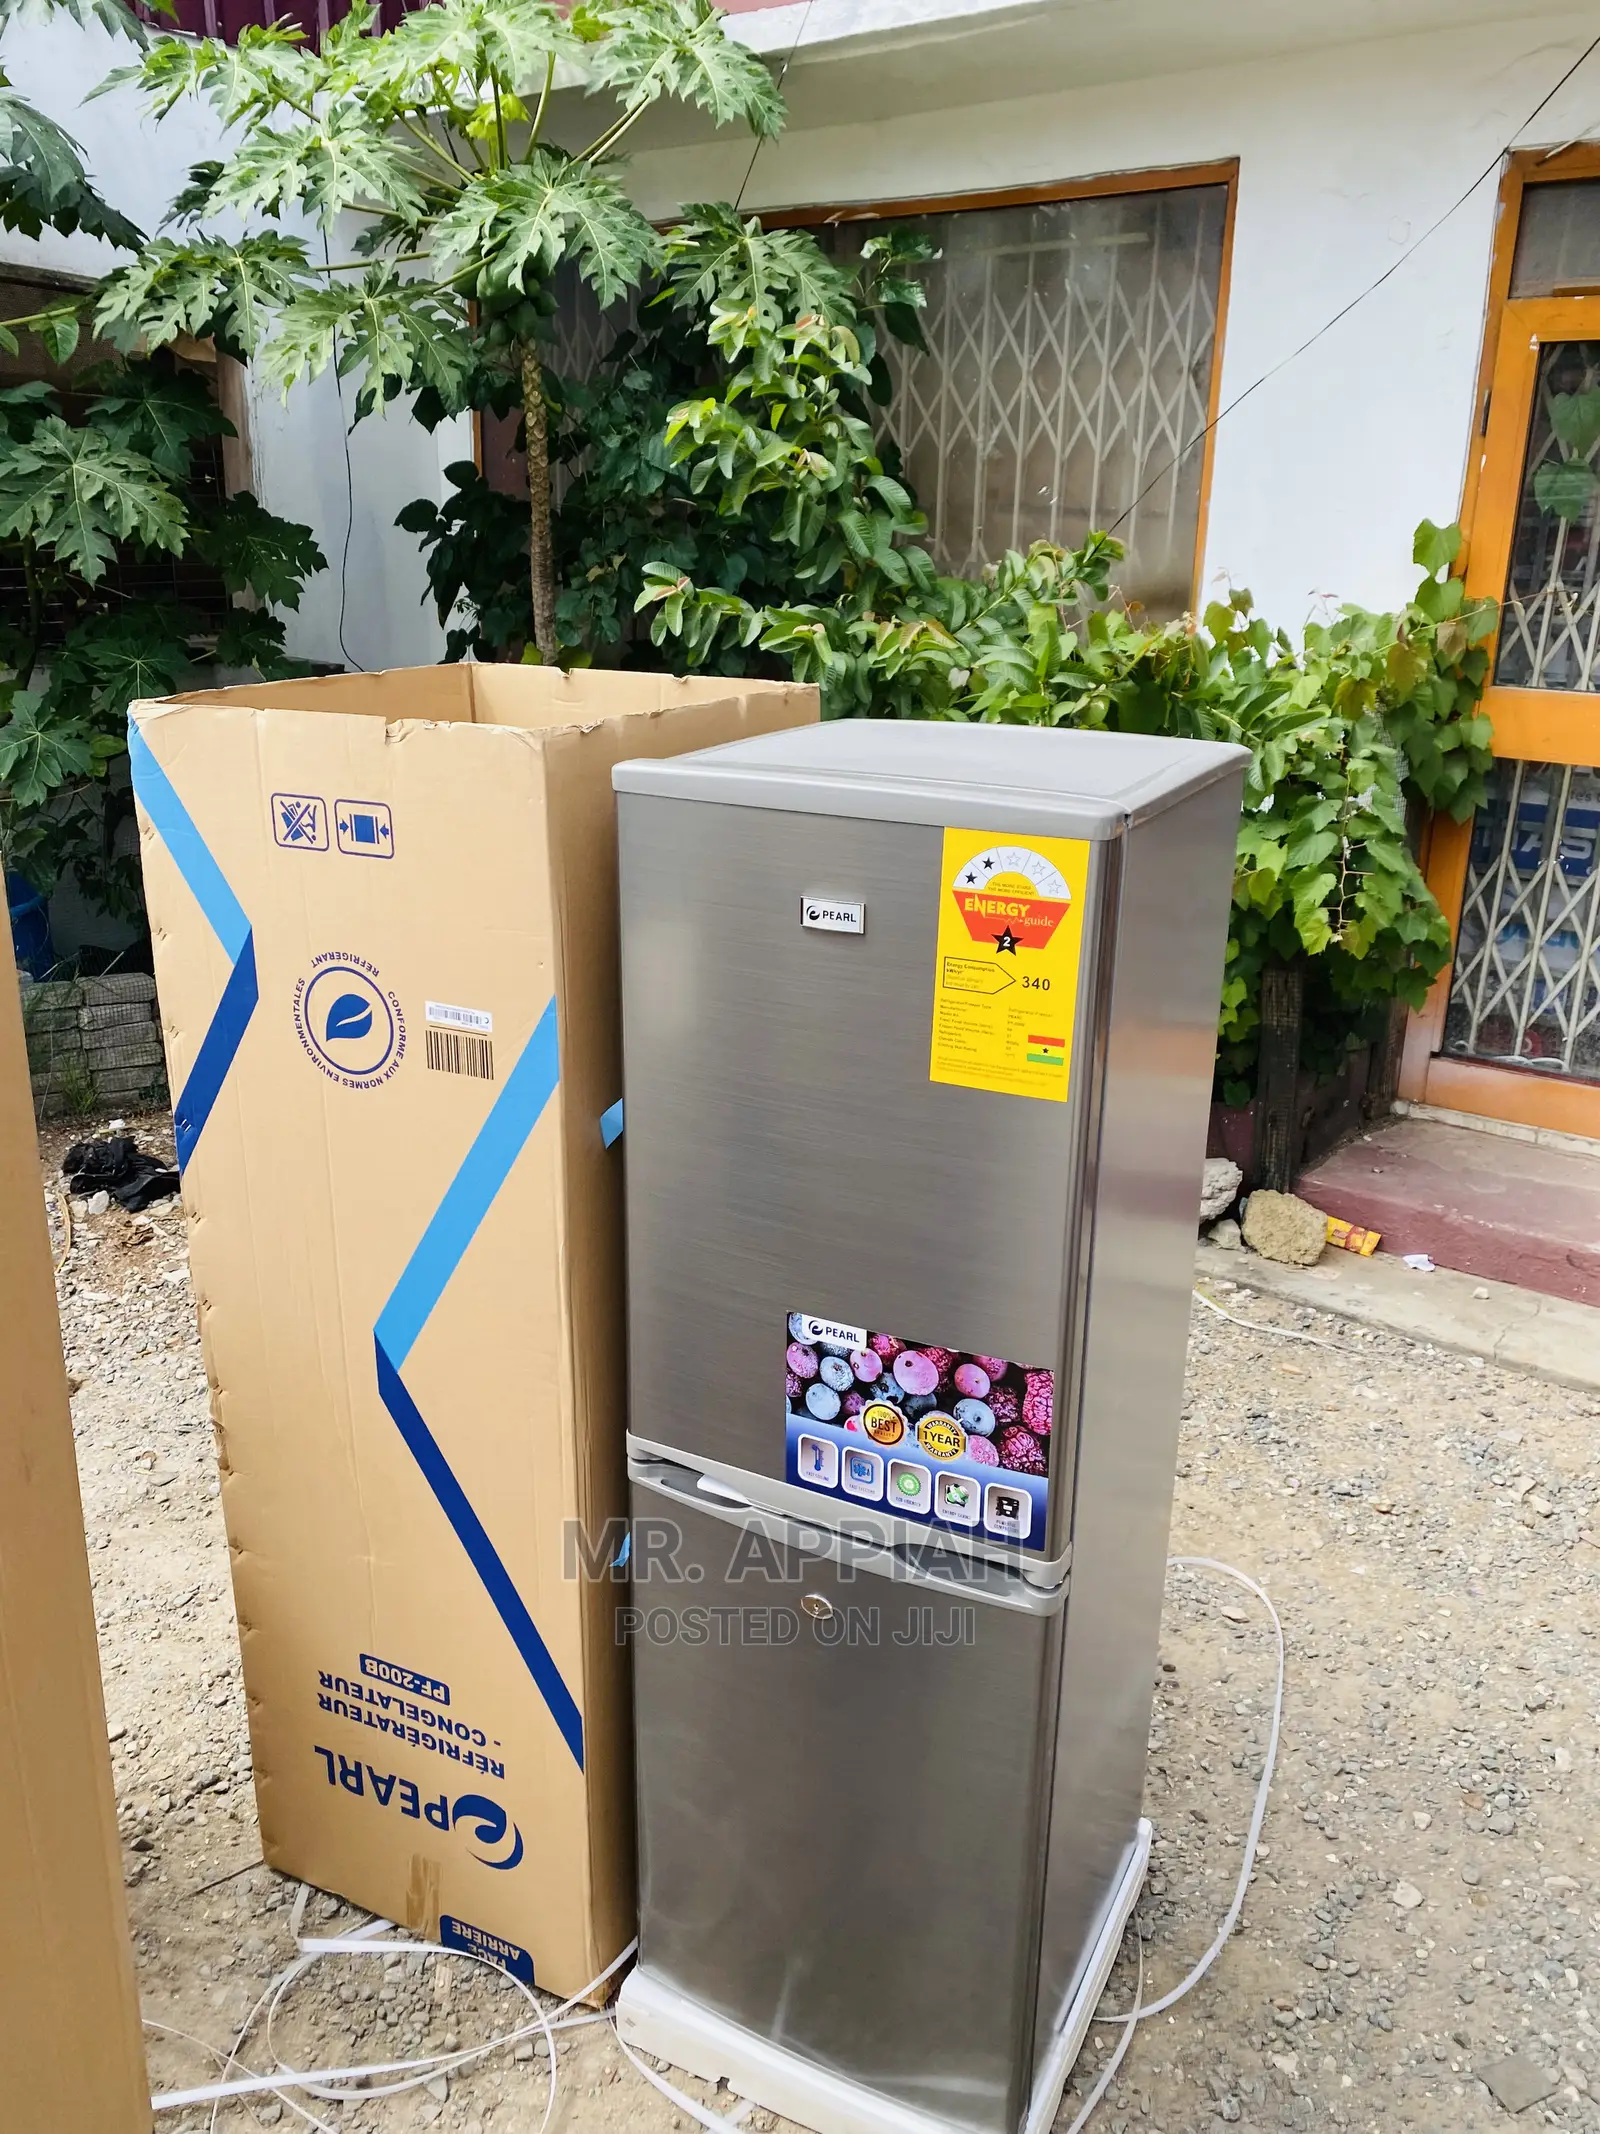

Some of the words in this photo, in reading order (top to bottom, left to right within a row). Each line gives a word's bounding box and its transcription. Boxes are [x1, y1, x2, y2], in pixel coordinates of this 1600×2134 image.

[964, 894, 1031, 918] ENERGY
[822, 910, 857, 922] PEARL
[1024, 916, 1054, 927] guide
[1003, 936, 1011, 947] 2
[1021, 975, 1051, 991] 340
[293, 977, 340, 1083] ENVIRONMENTALES
[387, 991, 407, 1060] CONFORME
[385, 1059, 400, 1081] AUX
[342, 1075, 384, 1090] NORMES
[825, 1325, 860, 1344] PEARL
[871, 1416, 897, 1433] BEST
[926, 1420, 958, 1436] WARRANTY
[923, 1430, 928, 1440] 1
[930, 1431, 961, 1447] YEAR
[926, 1442, 957, 1458] WARRANTY
[364, 1657, 446, 1702] PF-200B
[317, 1669, 487, 1748] CONGELATEUR
[316, 1692, 505, 1780] RÉFRIGÉRATEUR
[313, 1744, 450, 1832] PEARL
